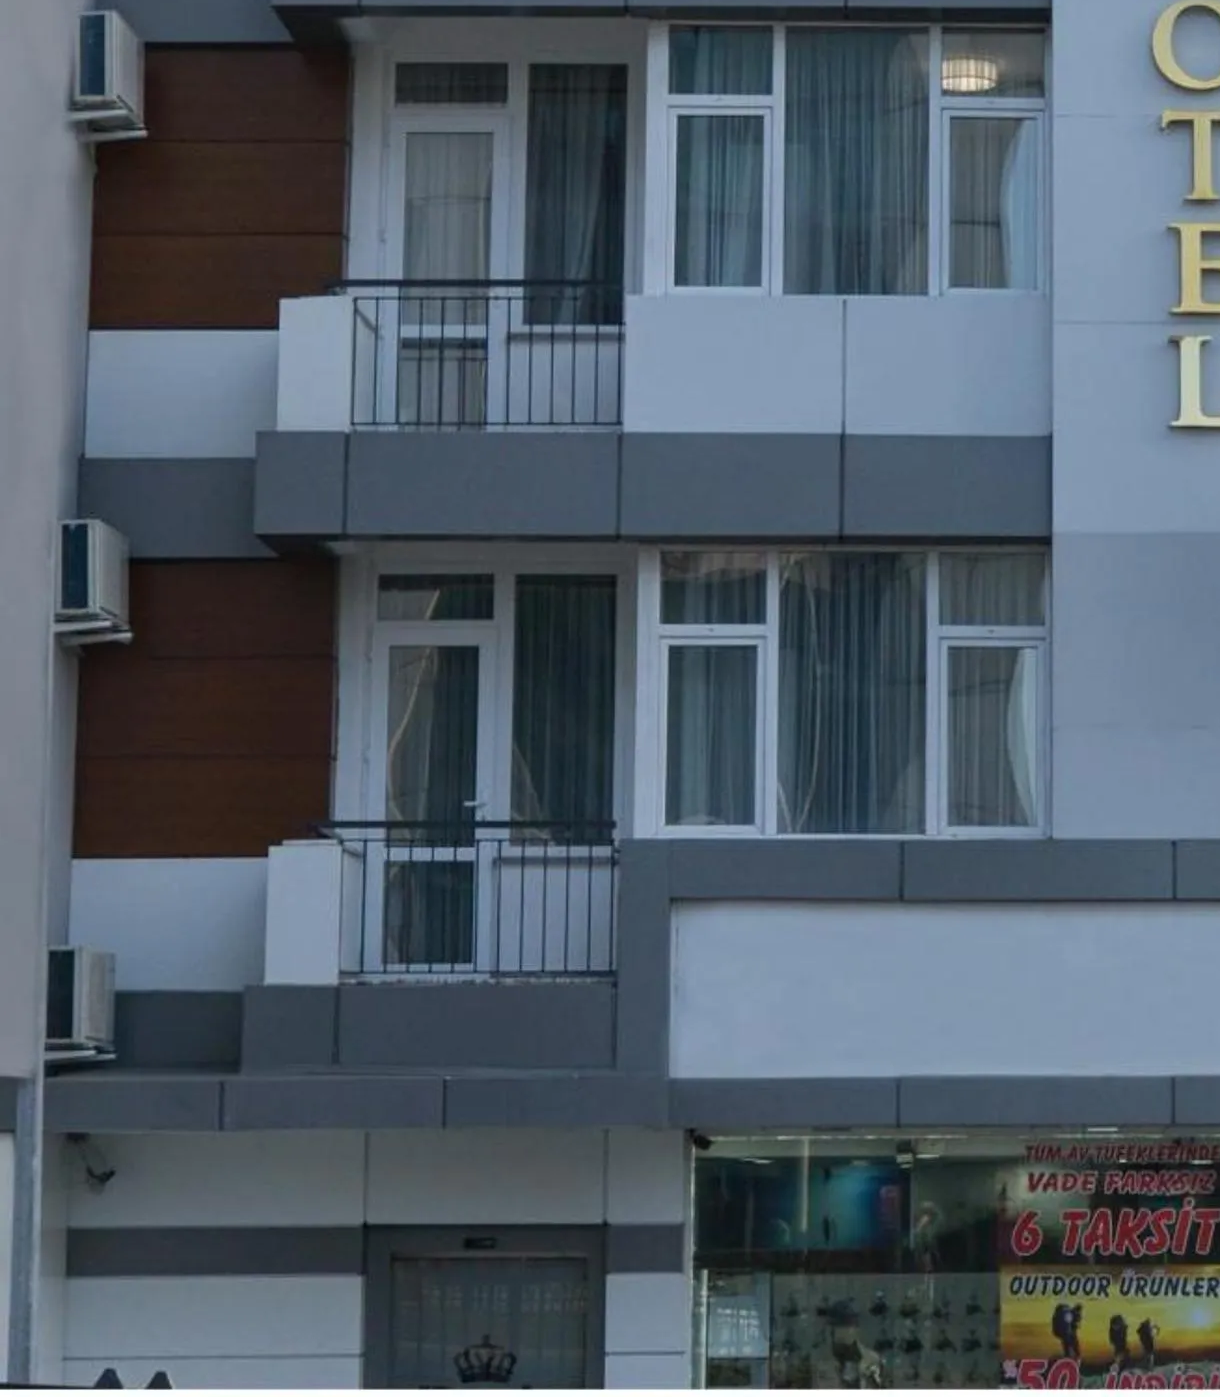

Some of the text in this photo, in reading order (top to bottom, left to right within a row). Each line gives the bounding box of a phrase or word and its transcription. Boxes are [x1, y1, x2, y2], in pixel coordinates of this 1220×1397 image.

[1027, 1170, 1218, 1195] VADE FARKSIZ
[1011, 1207, 1044, 1257] 6
[1009, 1274, 1112, 1297] OUTDOOR
